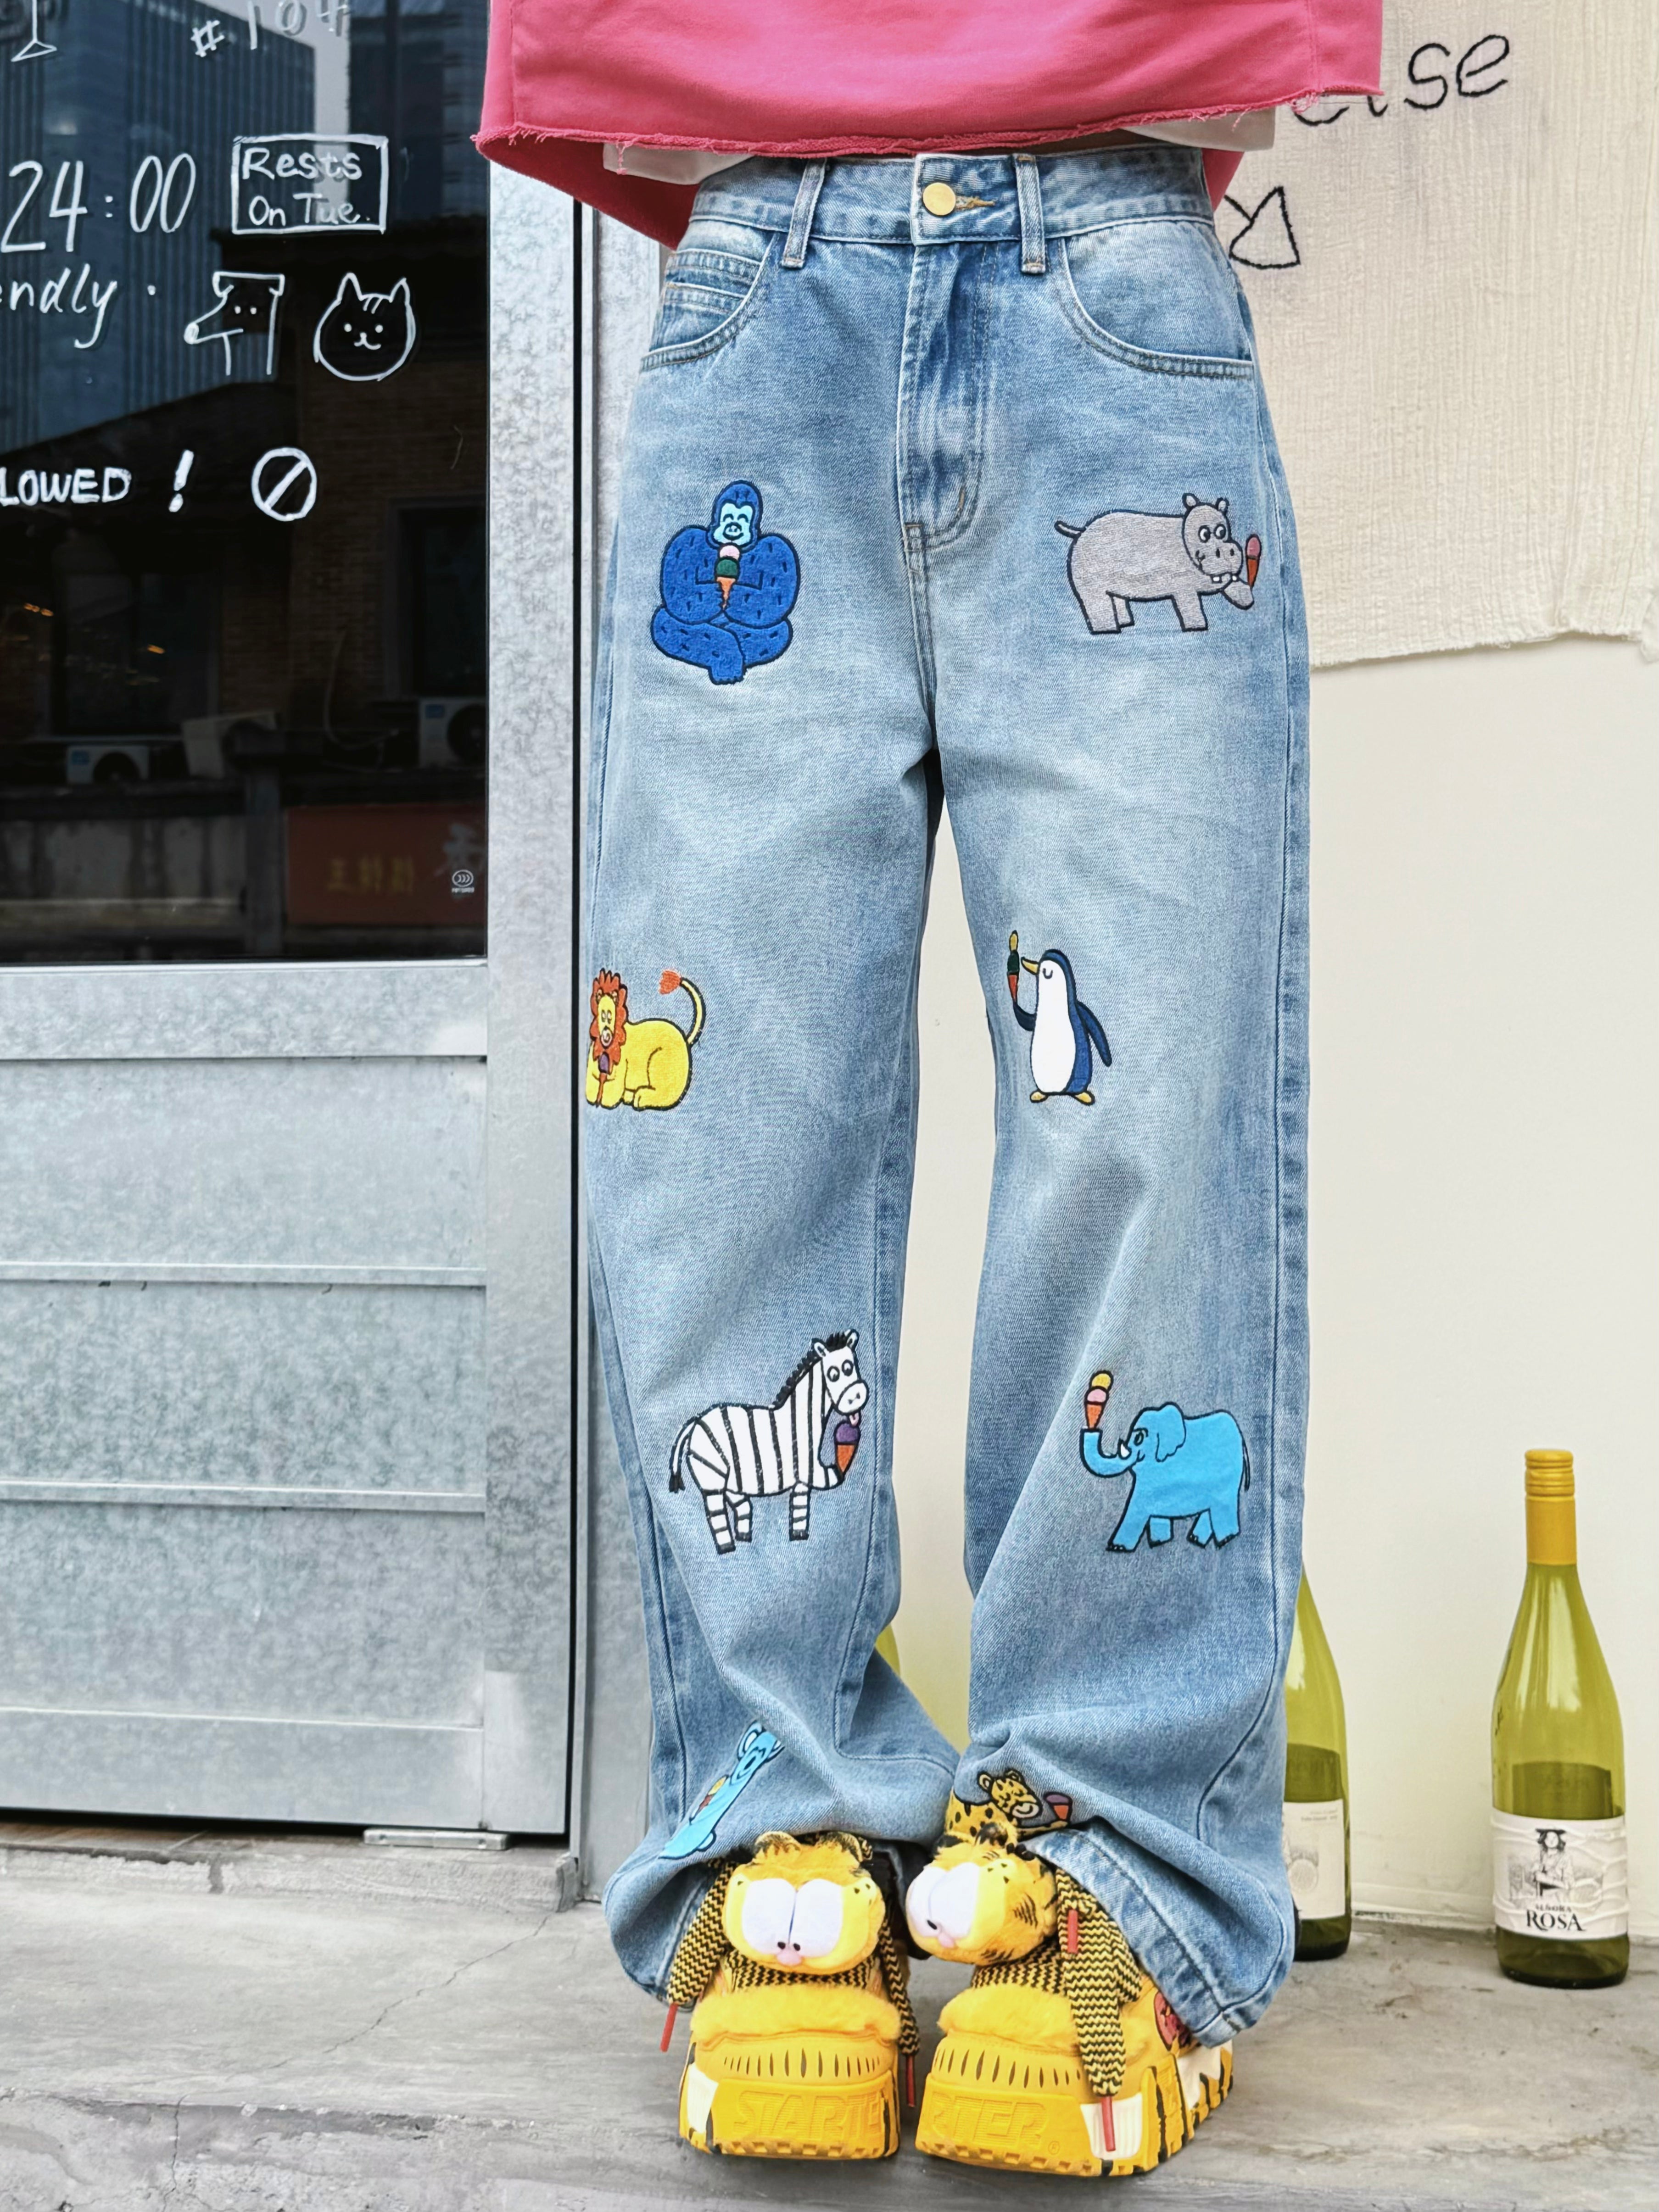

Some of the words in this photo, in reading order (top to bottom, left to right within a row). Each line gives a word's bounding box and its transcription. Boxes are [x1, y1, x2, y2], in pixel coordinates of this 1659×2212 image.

[242, 147, 363, 180] Rests
[0, 153, 196, 253] 24:00
[249, 195, 286, 226] On
[0, 263, 118, 349] ndly
[0, 467, 132, 506] LOWED
[1527, 1909, 1586, 1931] ROSA
